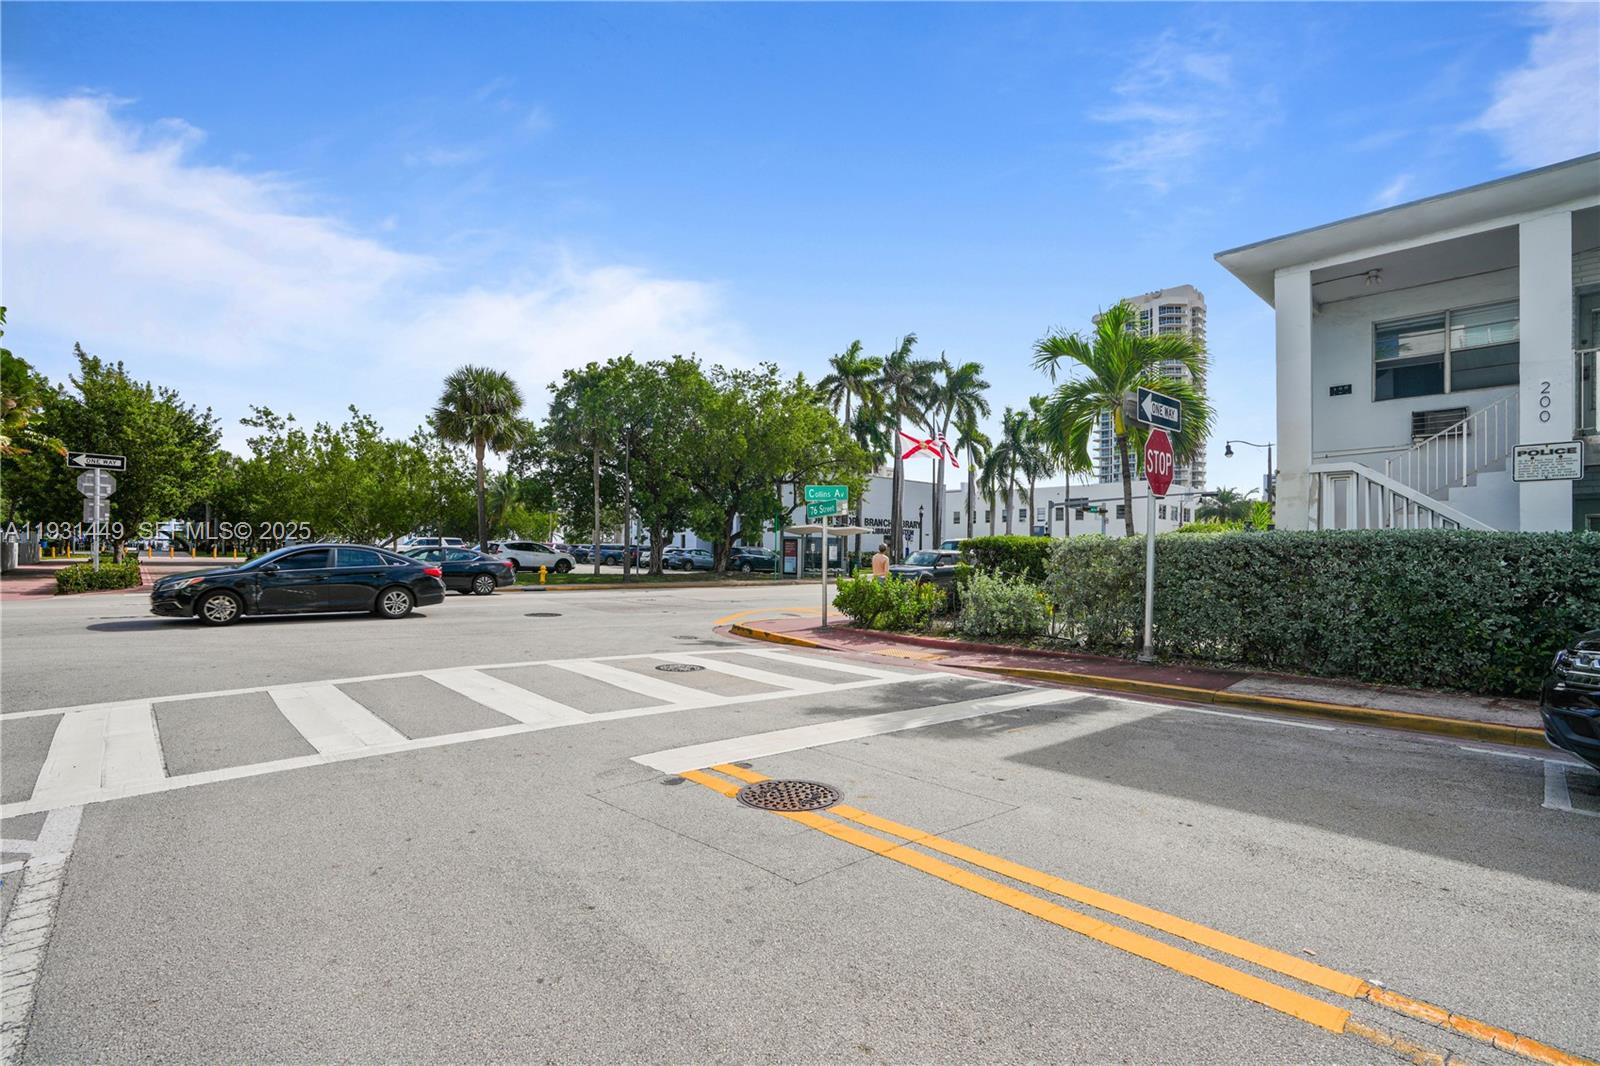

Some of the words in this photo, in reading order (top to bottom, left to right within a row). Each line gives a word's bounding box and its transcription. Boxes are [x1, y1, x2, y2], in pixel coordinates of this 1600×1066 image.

[1540, 381, 1551, 423] 200
[1151, 402, 1163, 416] ONE
[1164, 406, 1176, 419] WAY
[1517, 447, 1577, 457] POLICE
[1147, 449, 1172, 475] STOP
[809, 488, 831, 498] Collins
[834, 489, 845, 498] Av
[810, 506, 818, 515] 76
[819, 504, 835, 514] Street
